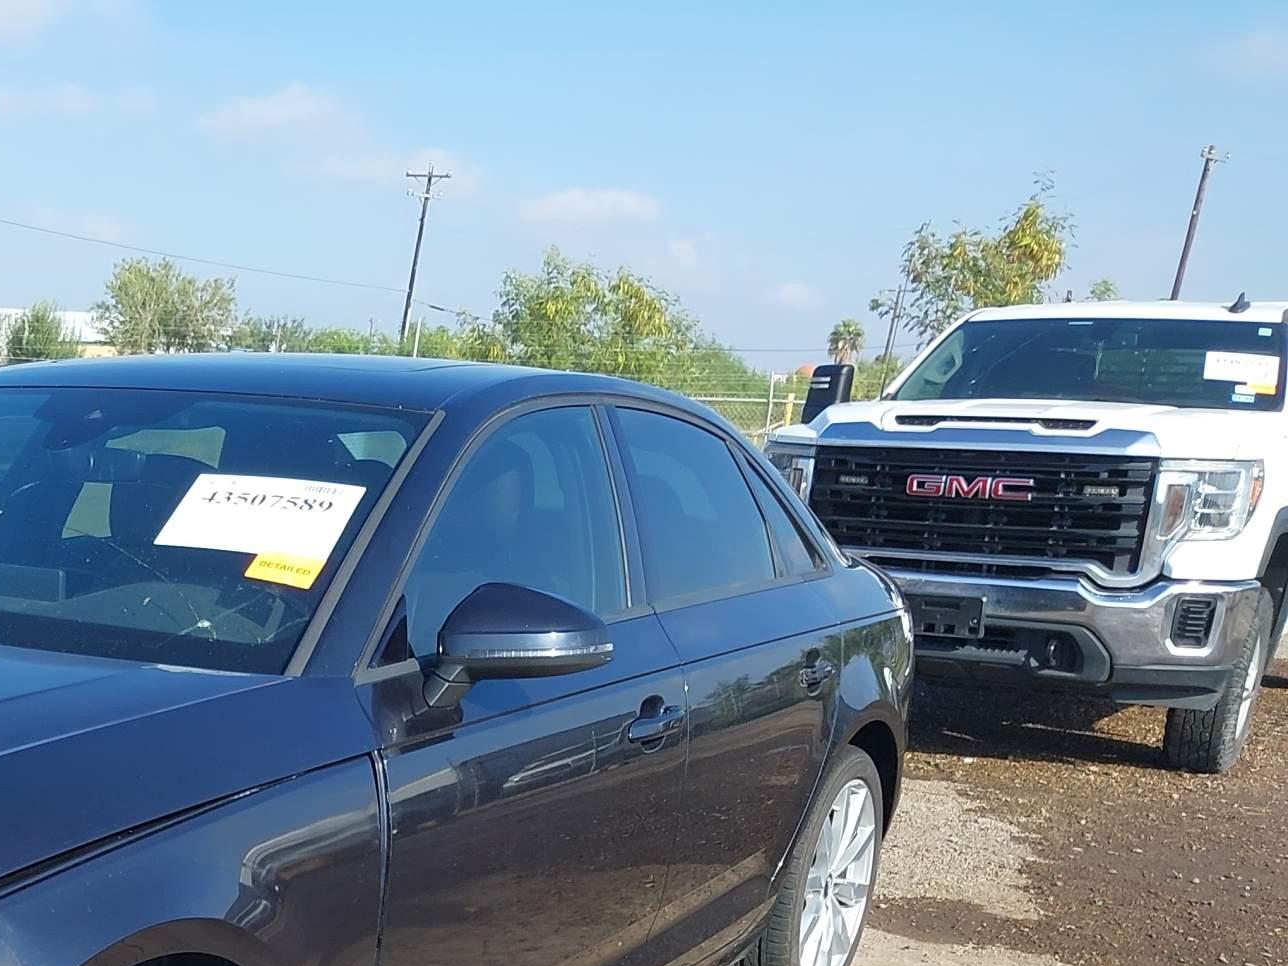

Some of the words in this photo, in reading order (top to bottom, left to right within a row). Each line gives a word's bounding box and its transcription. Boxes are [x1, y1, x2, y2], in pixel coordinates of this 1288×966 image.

[906, 474, 1034, 501] GMC
[202, 490, 334, 512] 43507589
[258, 560, 312, 576] DETAILED
